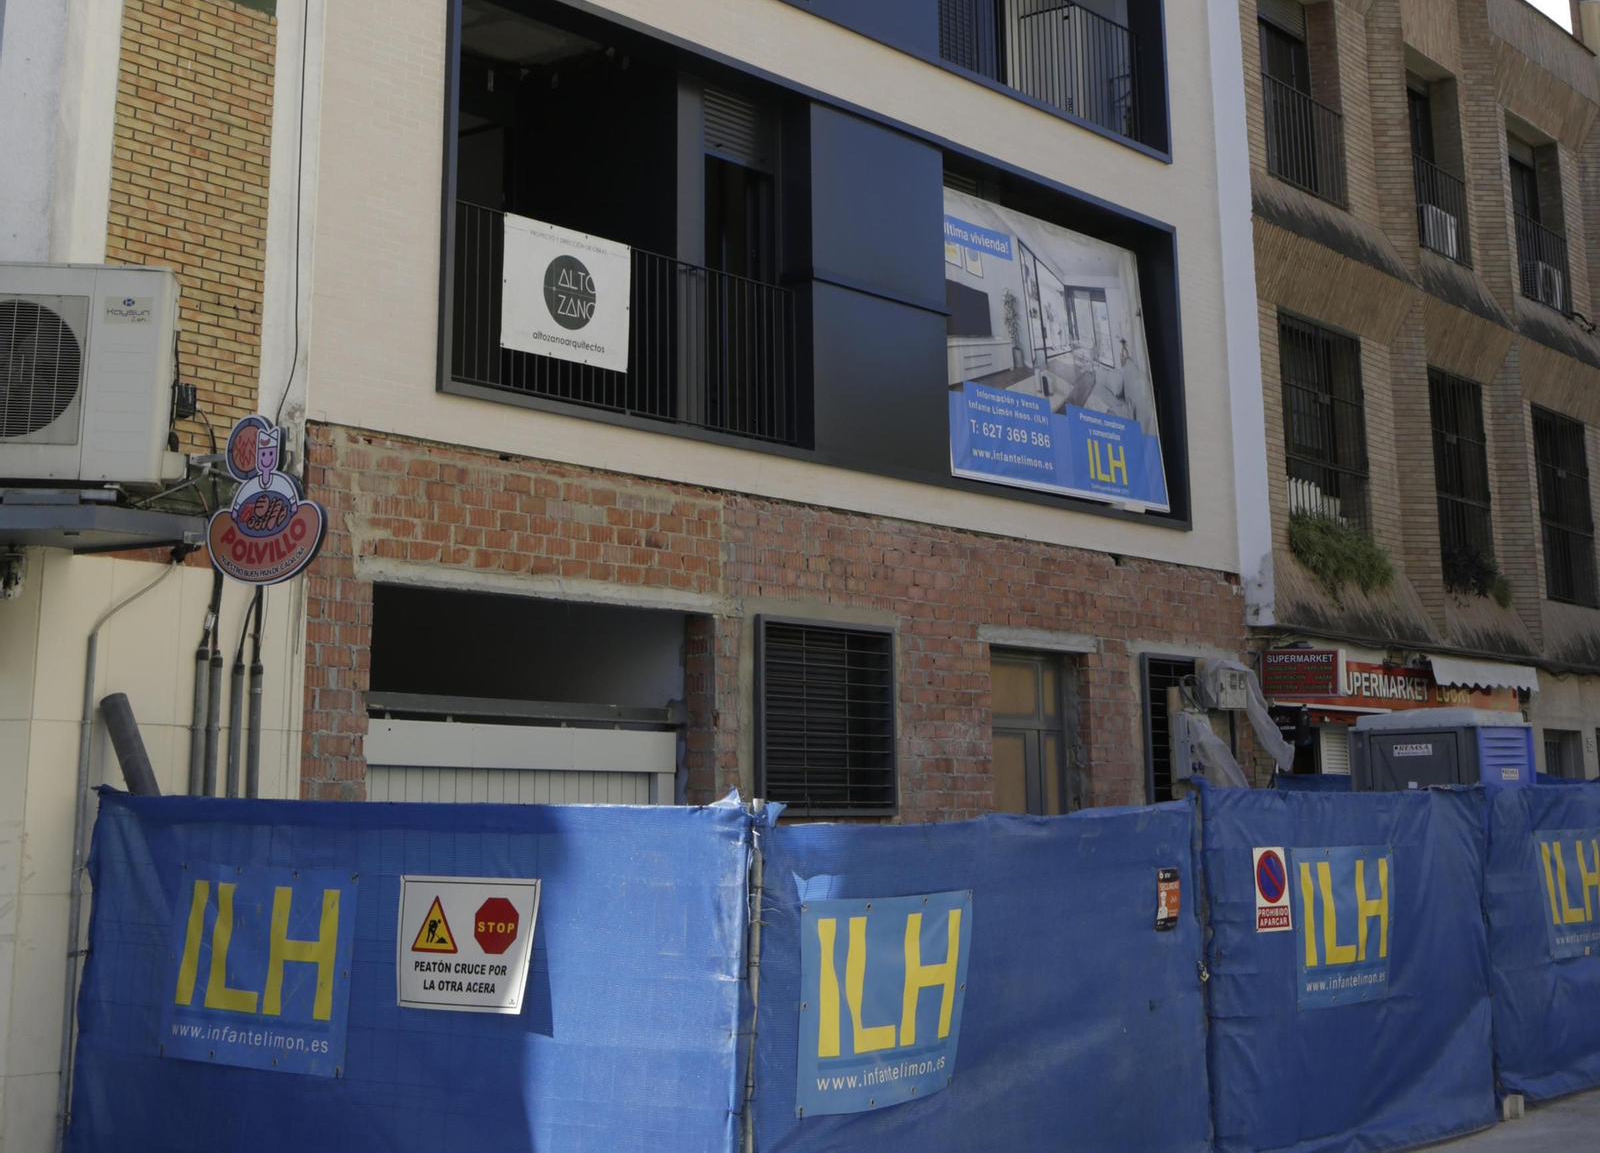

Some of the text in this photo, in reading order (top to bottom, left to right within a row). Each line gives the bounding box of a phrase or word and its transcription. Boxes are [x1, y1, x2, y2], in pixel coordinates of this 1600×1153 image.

[970, 232, 1010, 254] vivienda!
[558, 268, 596, 294] ALTO
[557, 294, 596, 320] ZANO
[532, 331, 605, 354] altozanoarquitectos
[976, 389, 1039, 410] Información y Venta
[968, 400, 1049, 426] Infante Limón Hnos. (ILH)
[970, 419, 1051, 448] T: 627 369 586
[971, 448, 1054, 470] www.infantelimon.es
[1087, 438, 1129, 486] ILH
[220, 518, 307, 565] POLVILLO
[220, 555, 244, 576] NUESTRO
[243, 568, 260, 578] BUEN
[260, 568, 272, 577] PAN
[271, 565, 280, 574] DE
[280, 557, 297, 571] CADA
[1266, 654, 1334, 663] SUPERMARKET
[1345, 670, 1429, 702] UPERMARKET
[1541, 839, 1600, 925] ILH
[1257, 907, 1289, 917] PROHIBIDO
[1260, 917, 1288, 927] APARCAR
[1299, 857, 1389, 967] ILH
[477, 921, 515, 934] STOP
[174, 879, 341, 1021] ILH
[414, 960, 508, 977] PEATÓN CRUCE POR
[1305, 971, 1386, 992] www.infantelimon.es
[423, 979, 496, 994] LA OTRA ACERA
[817, 908, 962, 1058] ILH
[171, 1022, 329, 1054] www.infantelimon.es
[816, 1056, 946, 1091] www.infantelimon.es
